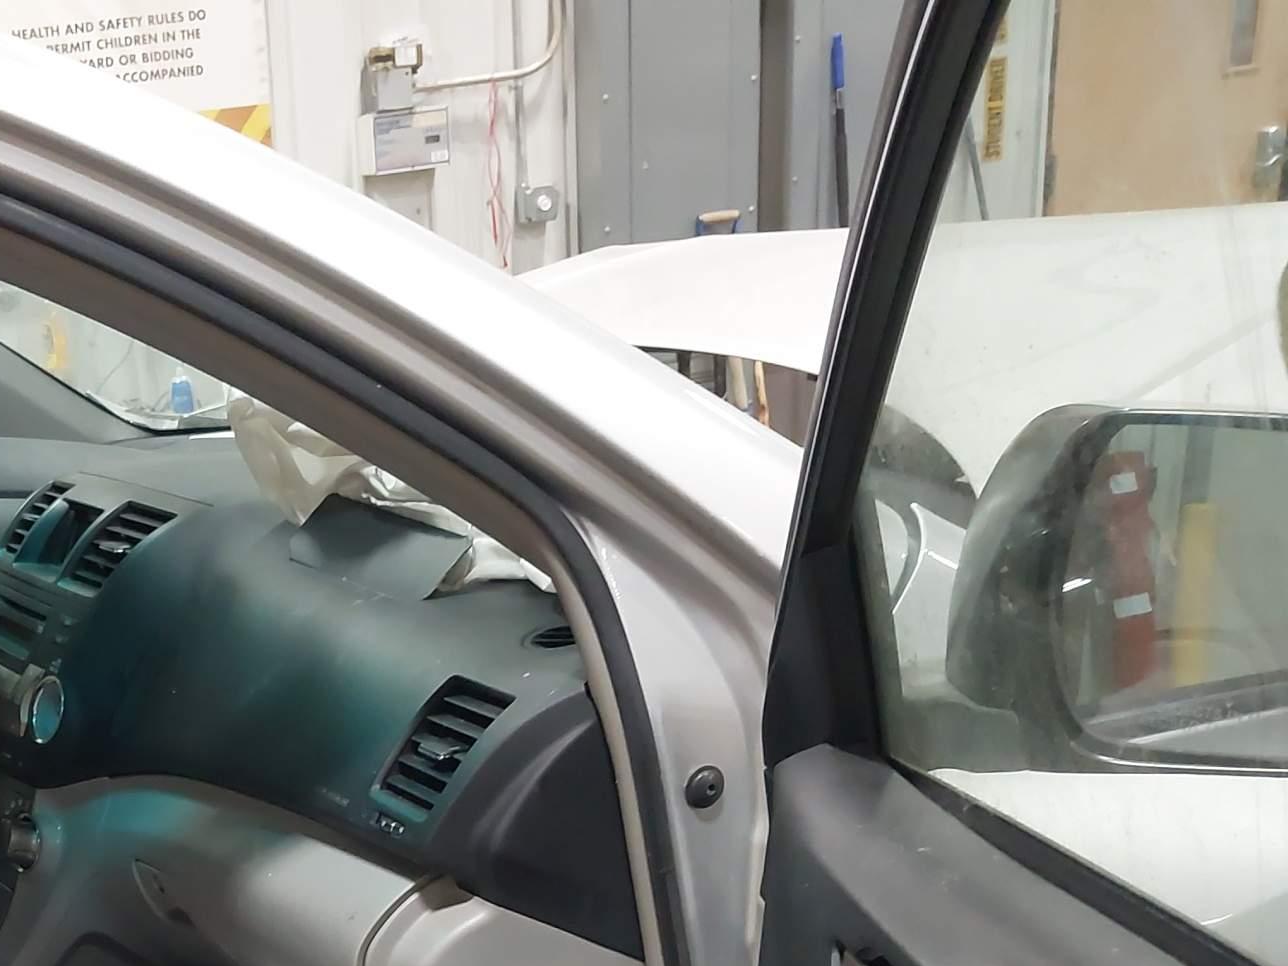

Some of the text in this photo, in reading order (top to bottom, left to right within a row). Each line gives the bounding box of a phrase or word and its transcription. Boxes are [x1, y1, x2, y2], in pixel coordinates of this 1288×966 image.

[65, 21, 94, 35] AND
[99, 16, 143, 32] SAFETY
[148, 11, 185, 26] RULES
[188, 9, 207, 22] DO
[96, 33, 158, 50] CHILDREN
[162, 30, 177, 44] IN
[181, 28, 201, 41] THE
[118, 53, 137, 66] OR
[141, 47, 194, 63] BIDDING
[115, 64, 204, 83] CCOMPANIED
